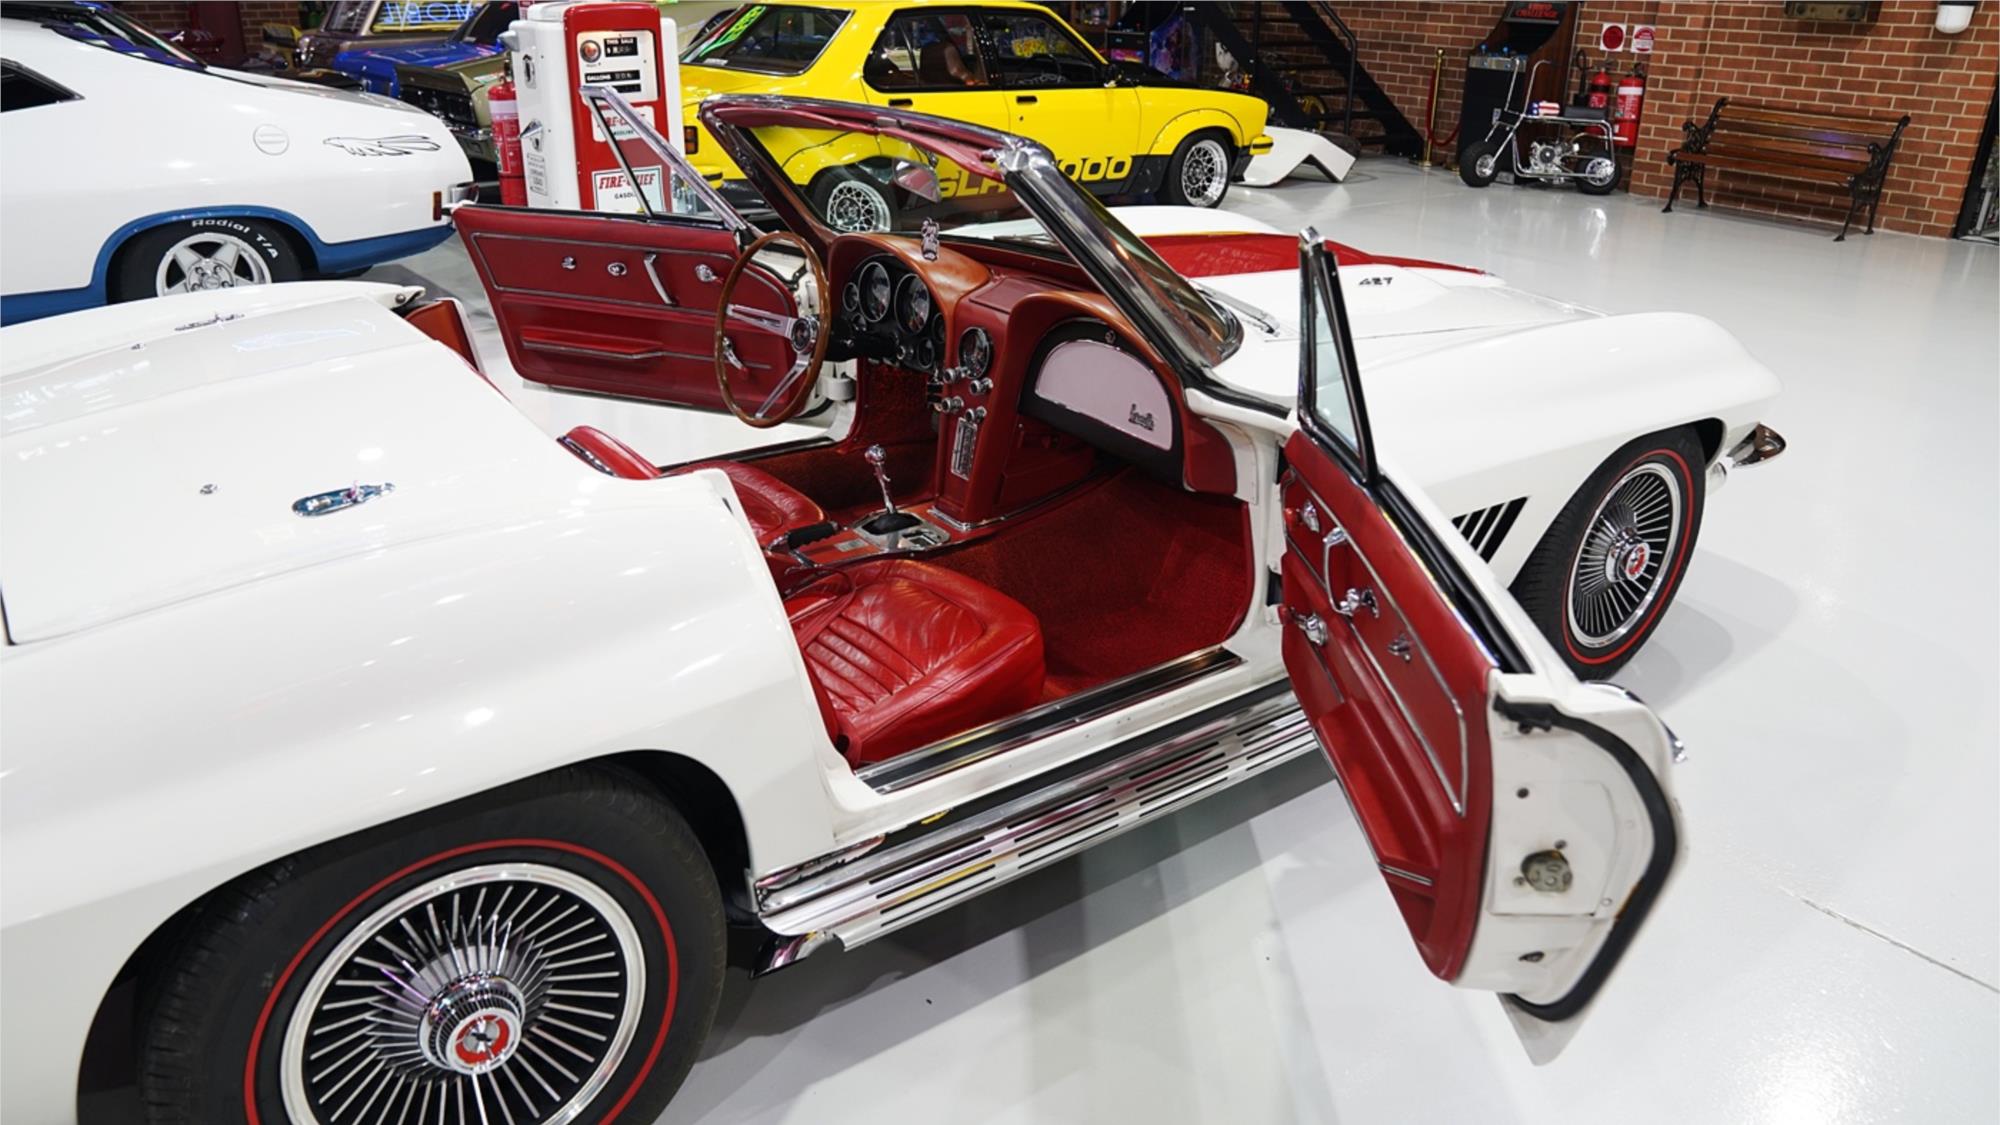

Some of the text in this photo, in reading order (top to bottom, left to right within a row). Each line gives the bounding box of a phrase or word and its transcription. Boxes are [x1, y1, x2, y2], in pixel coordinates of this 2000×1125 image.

[598, 173, 656, 190] FIRE-CIEF
[1057, 155, 1132, 182] 000
[192, 219, 279, 259] Radial T/A
